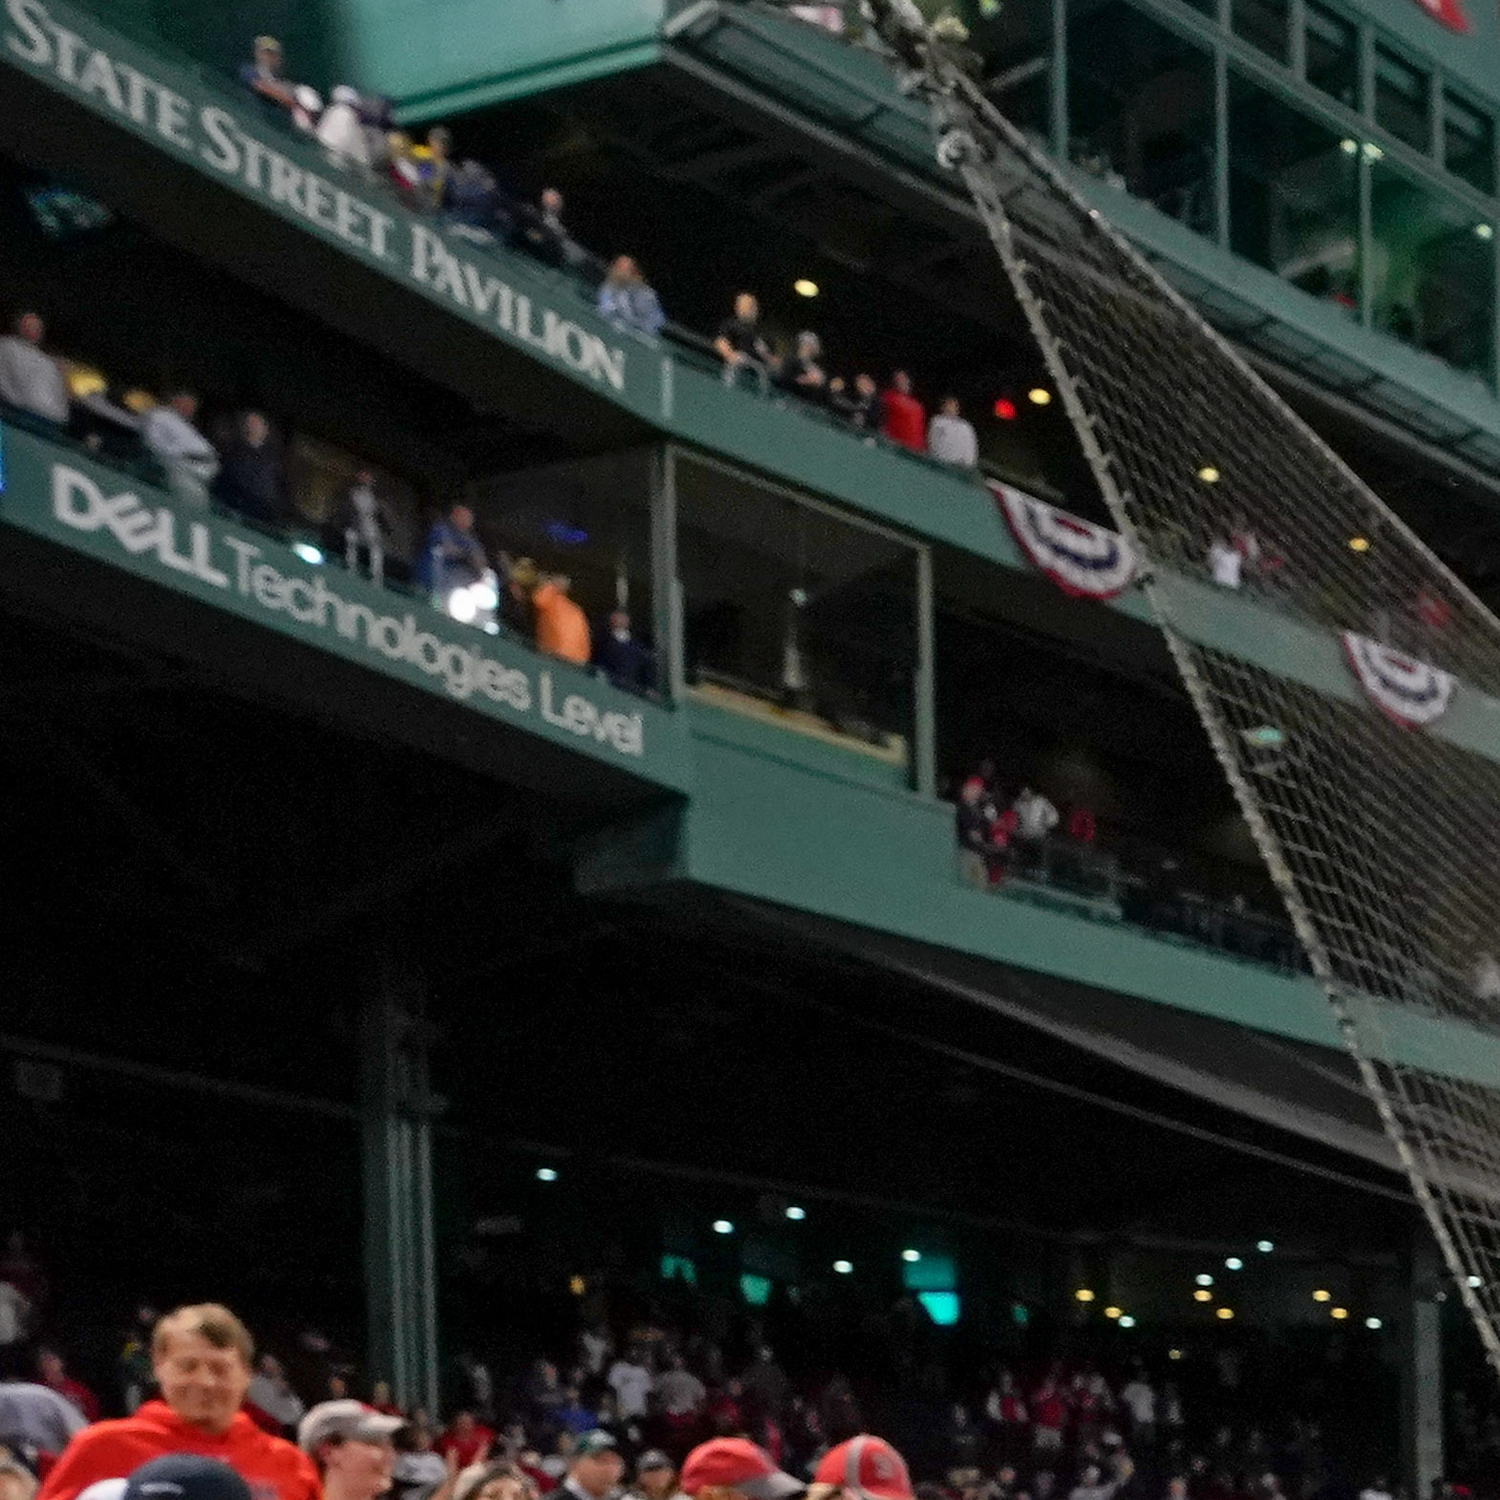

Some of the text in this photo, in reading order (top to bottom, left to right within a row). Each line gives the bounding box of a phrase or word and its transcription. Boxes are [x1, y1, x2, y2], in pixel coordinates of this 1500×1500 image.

[4, 0, 626, 391] STATE STREET PAVILION
[50, 463, 644, 757] DELL Technologies Level
